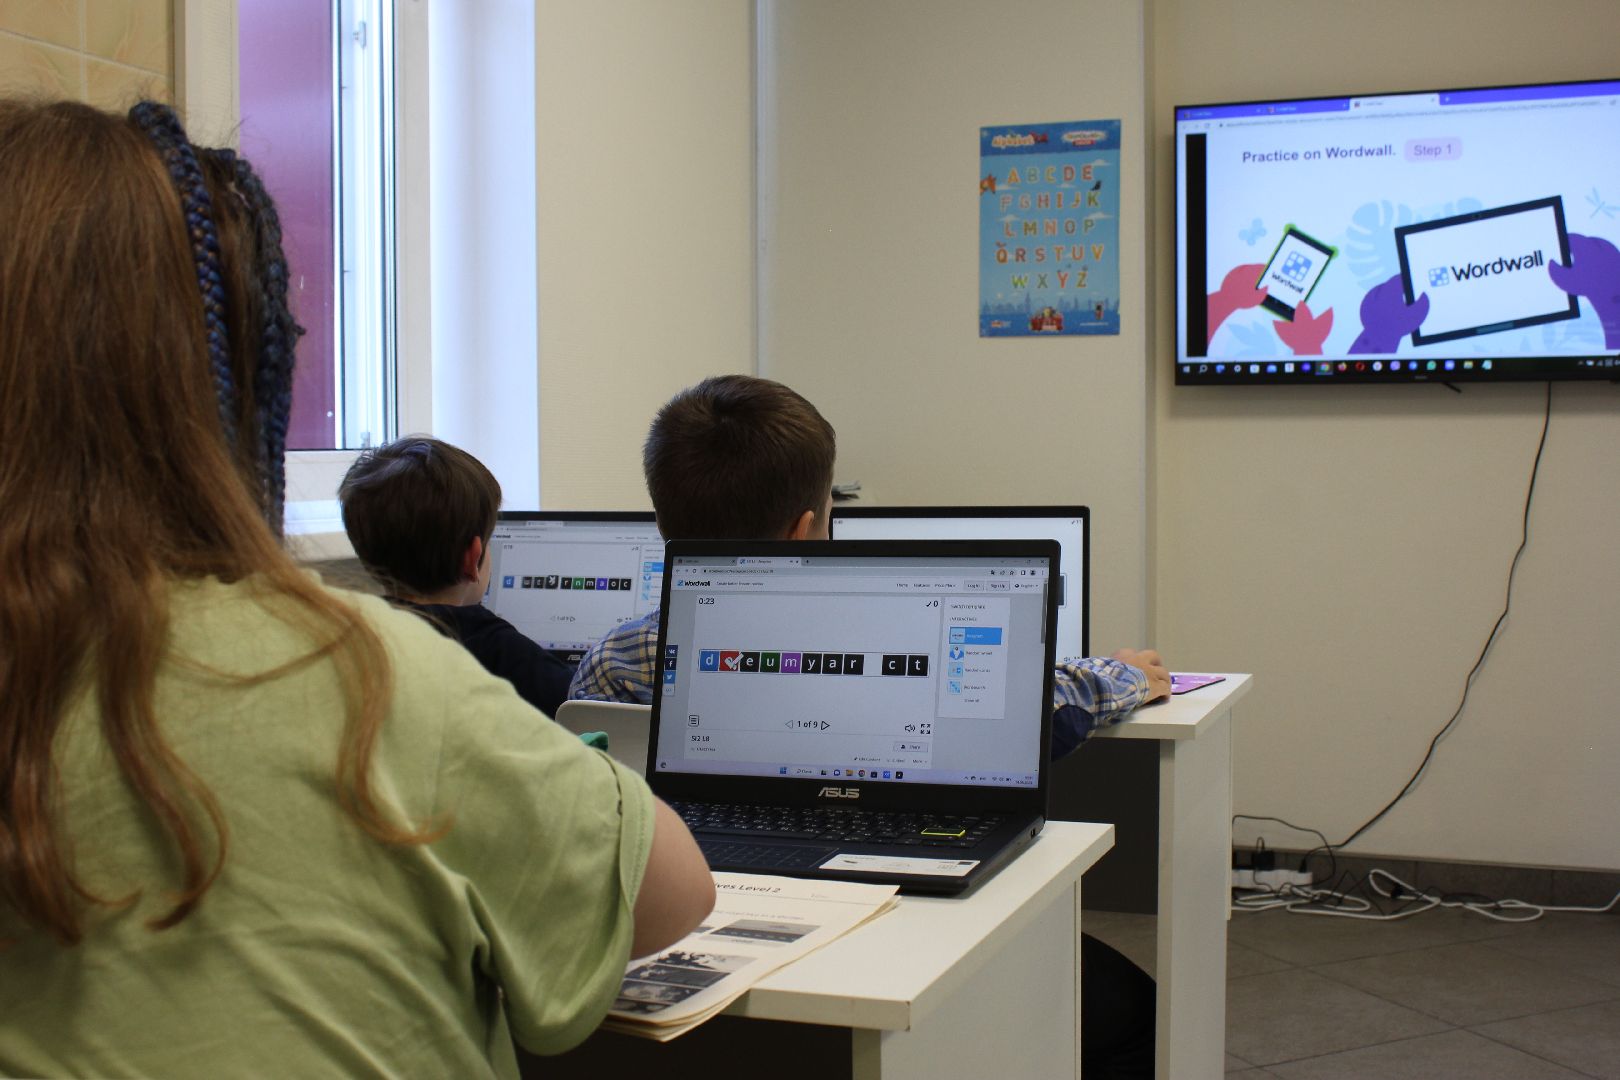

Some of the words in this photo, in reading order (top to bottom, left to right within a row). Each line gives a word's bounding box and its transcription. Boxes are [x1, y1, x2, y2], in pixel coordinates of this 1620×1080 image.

[1242, 149, 1299, 163] Practice
[1303, 151, 1321, 160] on
[1325, 144, 1396, 159] Wordwall.
[1413, 144, 1442, 157] Step
[1446, 143, 1453, 154] 1
[1451, 250, 1543, 281] Wordwall
[698, 597, 715, 605] 0:23
[803, 720, 812, 728] of
[813, 720, 818, 728] 9
[818, 787, 860, 799] ASUS
[739, 885, 771, 893] Level
